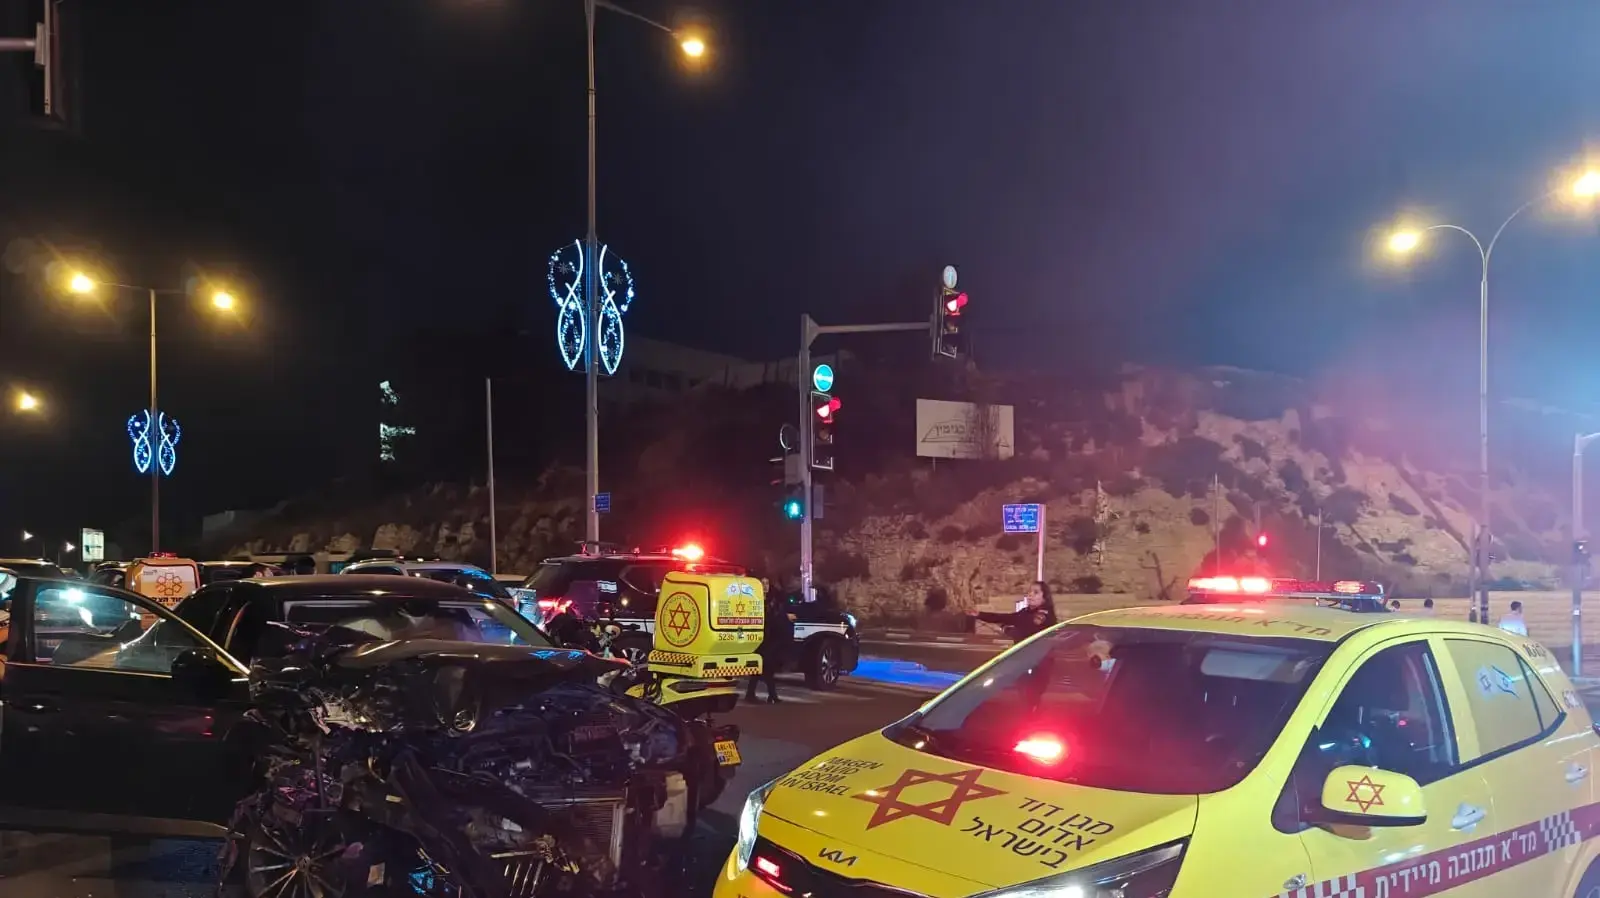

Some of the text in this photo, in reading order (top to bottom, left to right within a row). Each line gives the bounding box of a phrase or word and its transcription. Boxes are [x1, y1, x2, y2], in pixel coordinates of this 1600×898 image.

[794, 770, 847, 783] ADOM
[828, 756, 884, 770] MAGEN
[779, 777, 851, 796] IN ISRAEL
[1018, 797, 1115, 835] מגן דוד
[960, 816, 1068, 869] בישראל
[1017, 818, 1096, 851] אדום
[1375, 830, 1537, 898] מד"א תגובה מיידית
